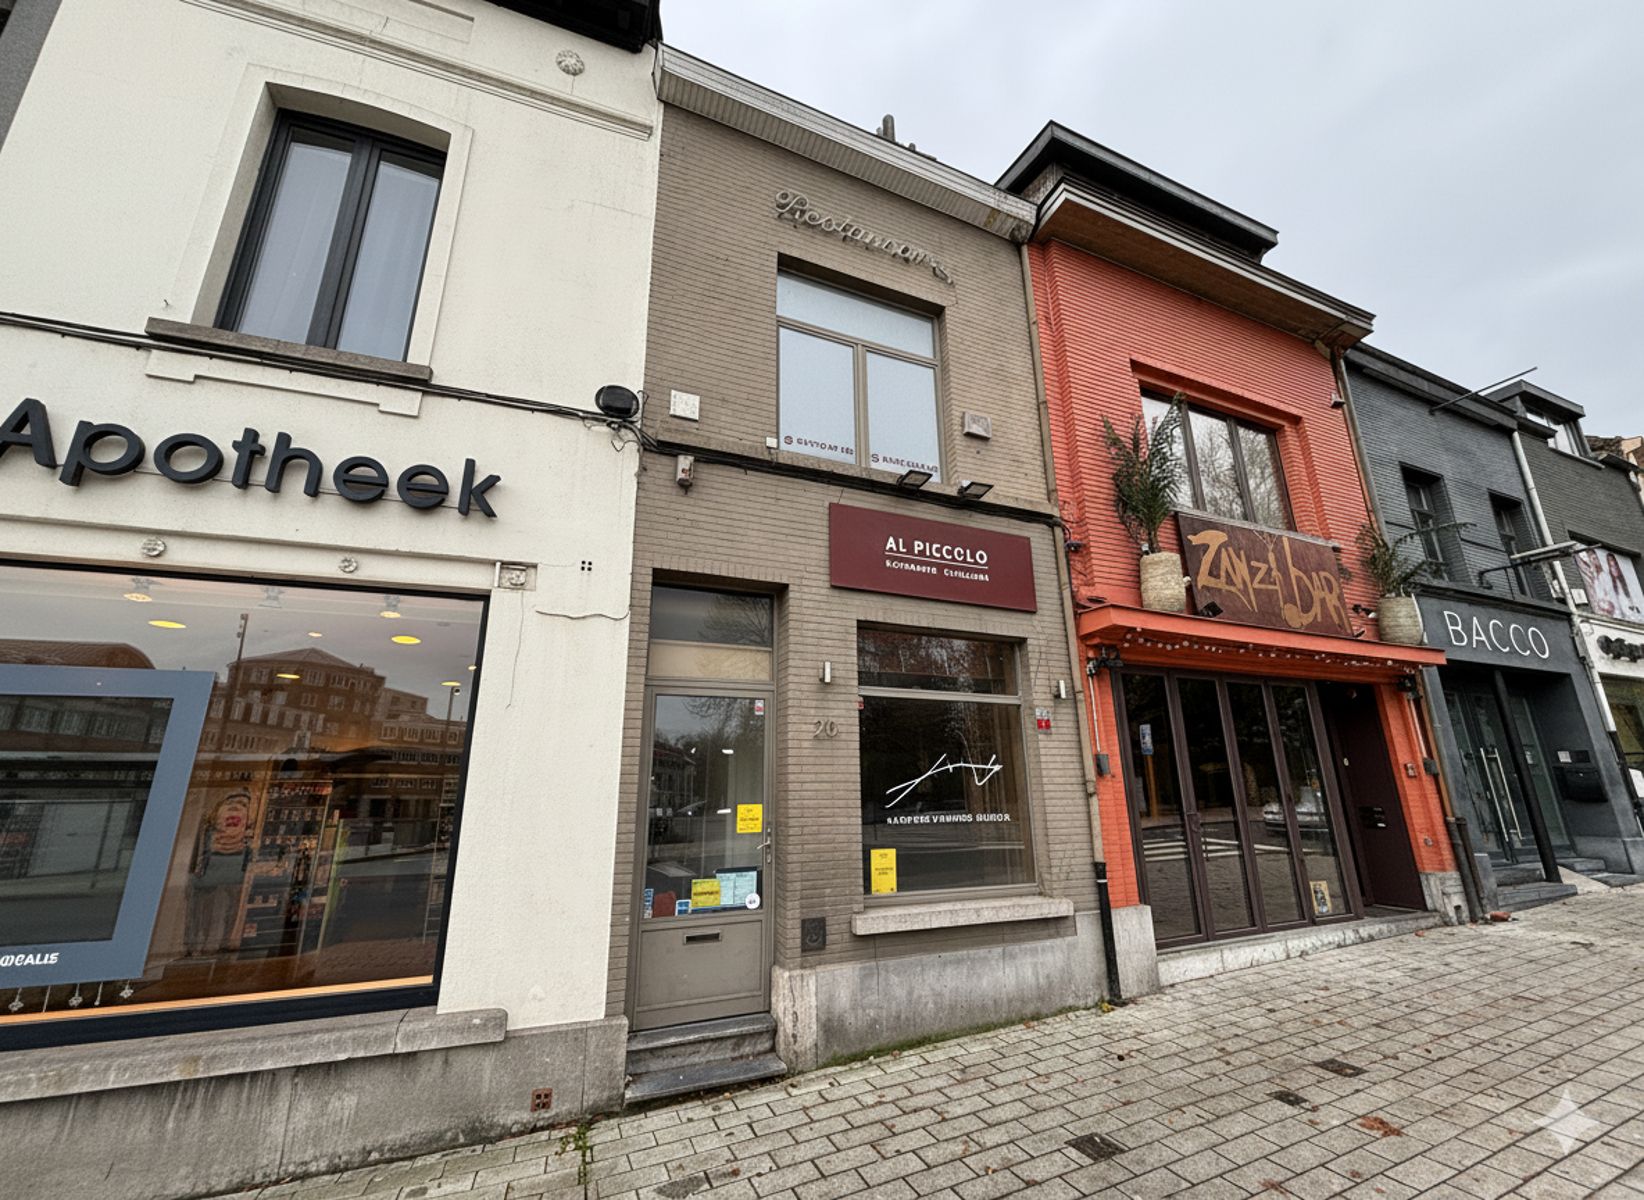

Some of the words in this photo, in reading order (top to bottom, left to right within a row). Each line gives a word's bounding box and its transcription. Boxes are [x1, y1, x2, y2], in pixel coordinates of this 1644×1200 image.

[0, 397, 501, 518] Apotheek
[885, 536, 907, 553] AL
[914, 541, 988, 565] PICCOLO
[1443, 610, 1550, 659] BACCO
[813, 720, 839, 740] 20
